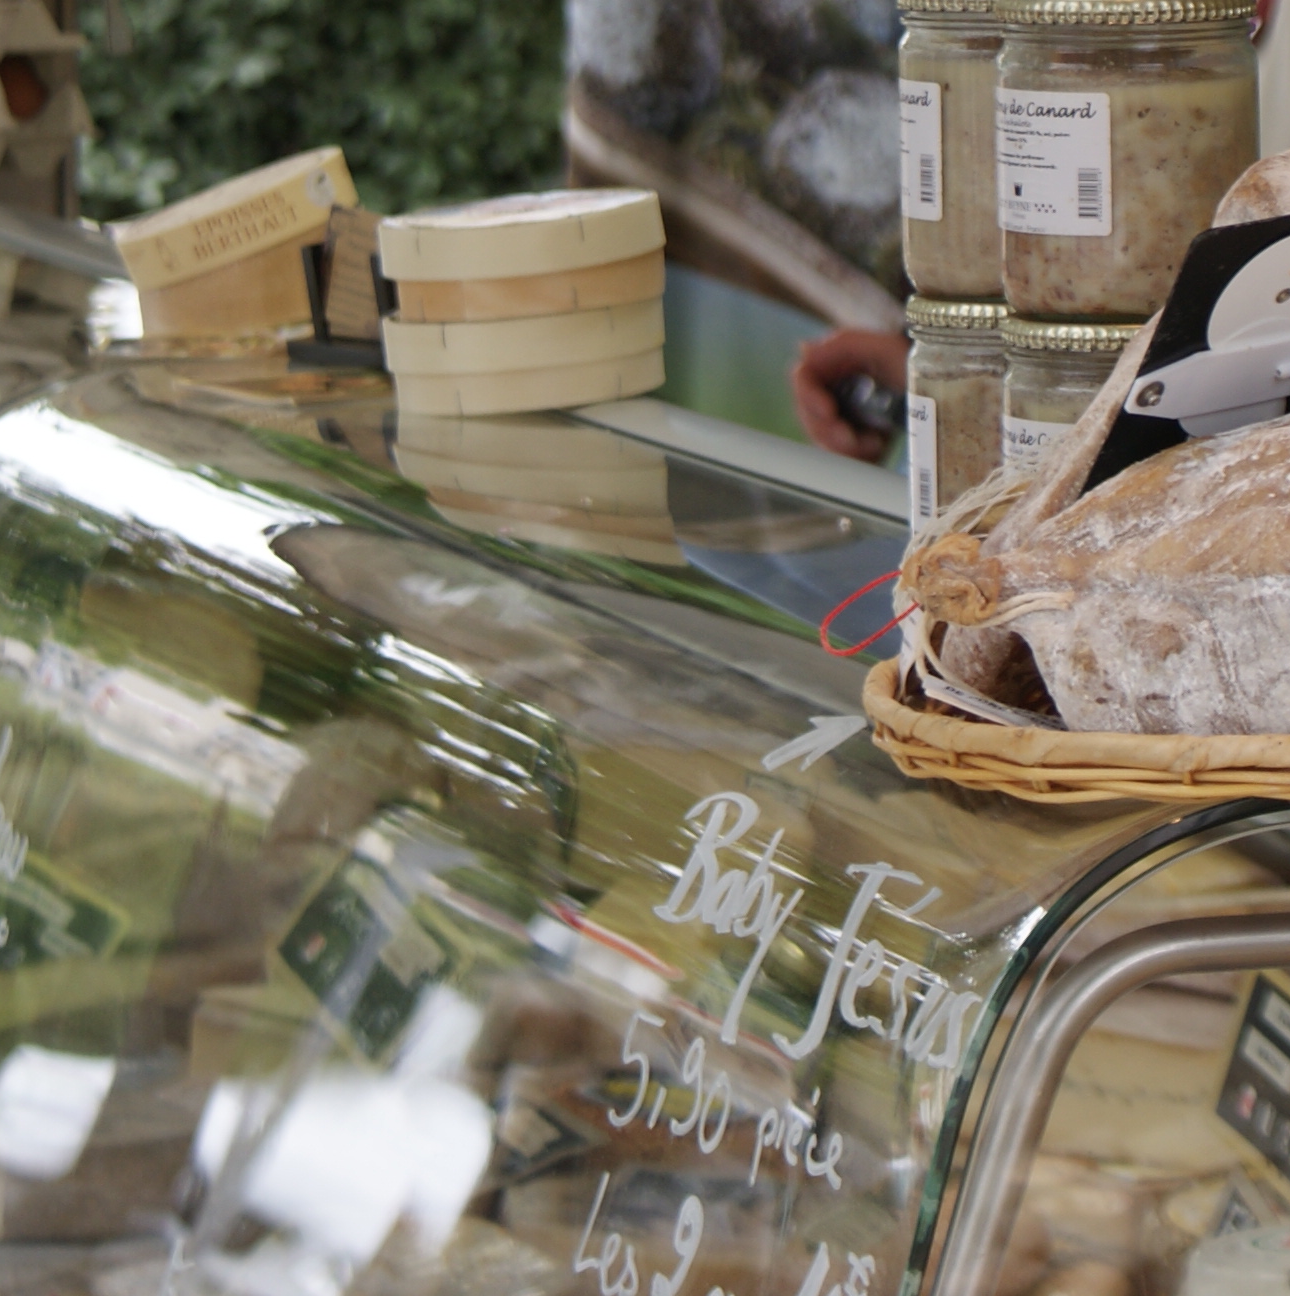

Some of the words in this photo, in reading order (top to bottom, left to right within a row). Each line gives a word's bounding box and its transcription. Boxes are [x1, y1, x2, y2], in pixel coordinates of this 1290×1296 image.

[1010, 98, 1025, 116] de
[1026, 101, 1097, 119] Canard
[653, 791, 804, 1045] Baby
[608, 1011, 731, 1155] 5,90
